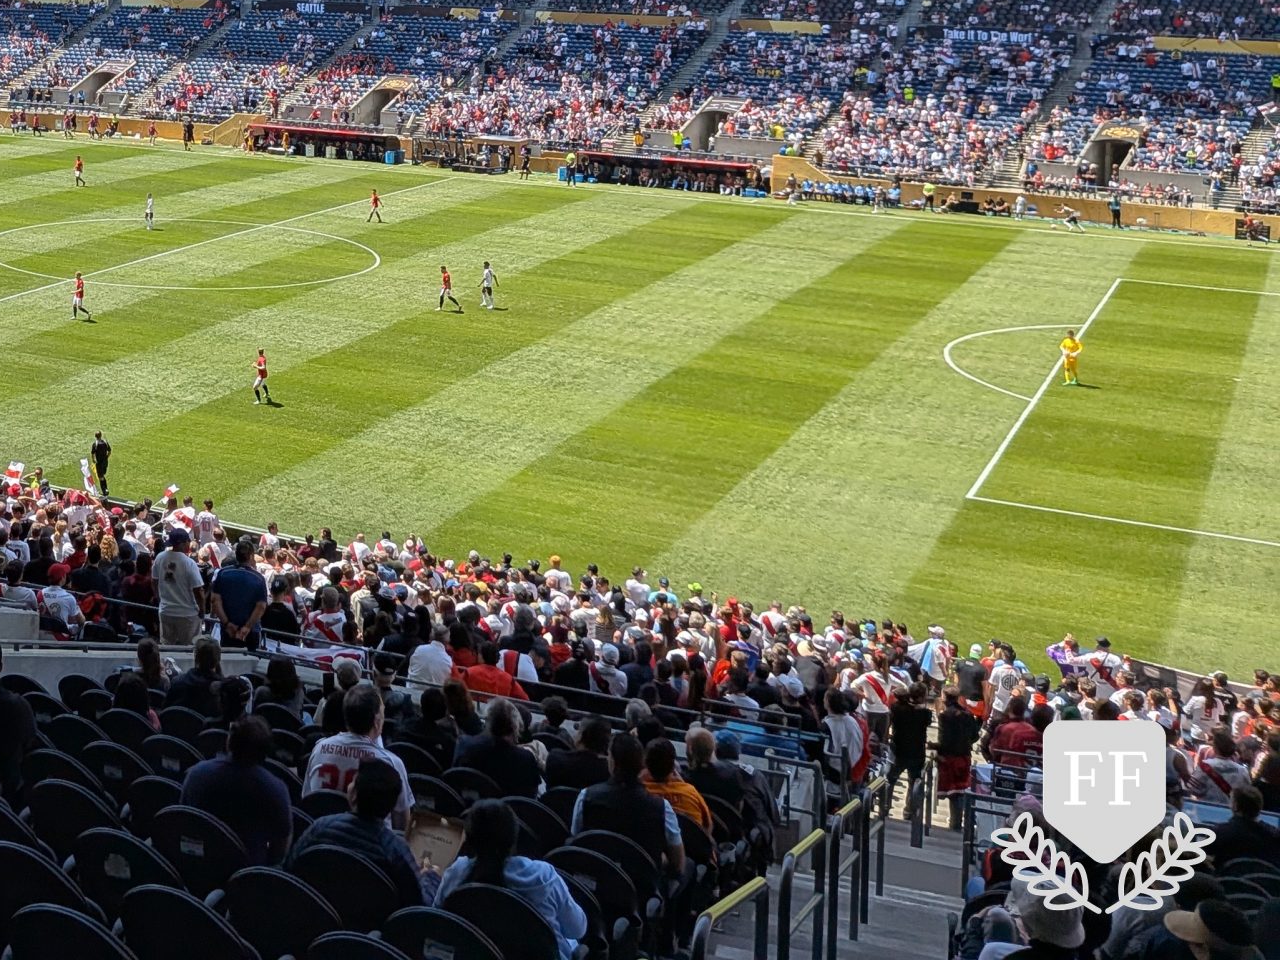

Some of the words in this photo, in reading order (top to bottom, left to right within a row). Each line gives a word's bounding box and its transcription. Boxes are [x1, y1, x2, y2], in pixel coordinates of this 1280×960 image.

[296, 3, 325, 13] SEATTLE
[943, 28, 965, 40] Take
[967, 30, 974, 40] It
[977, 30, 988, 40] To
[321, 744, 375, 759] MASTANTUONO
